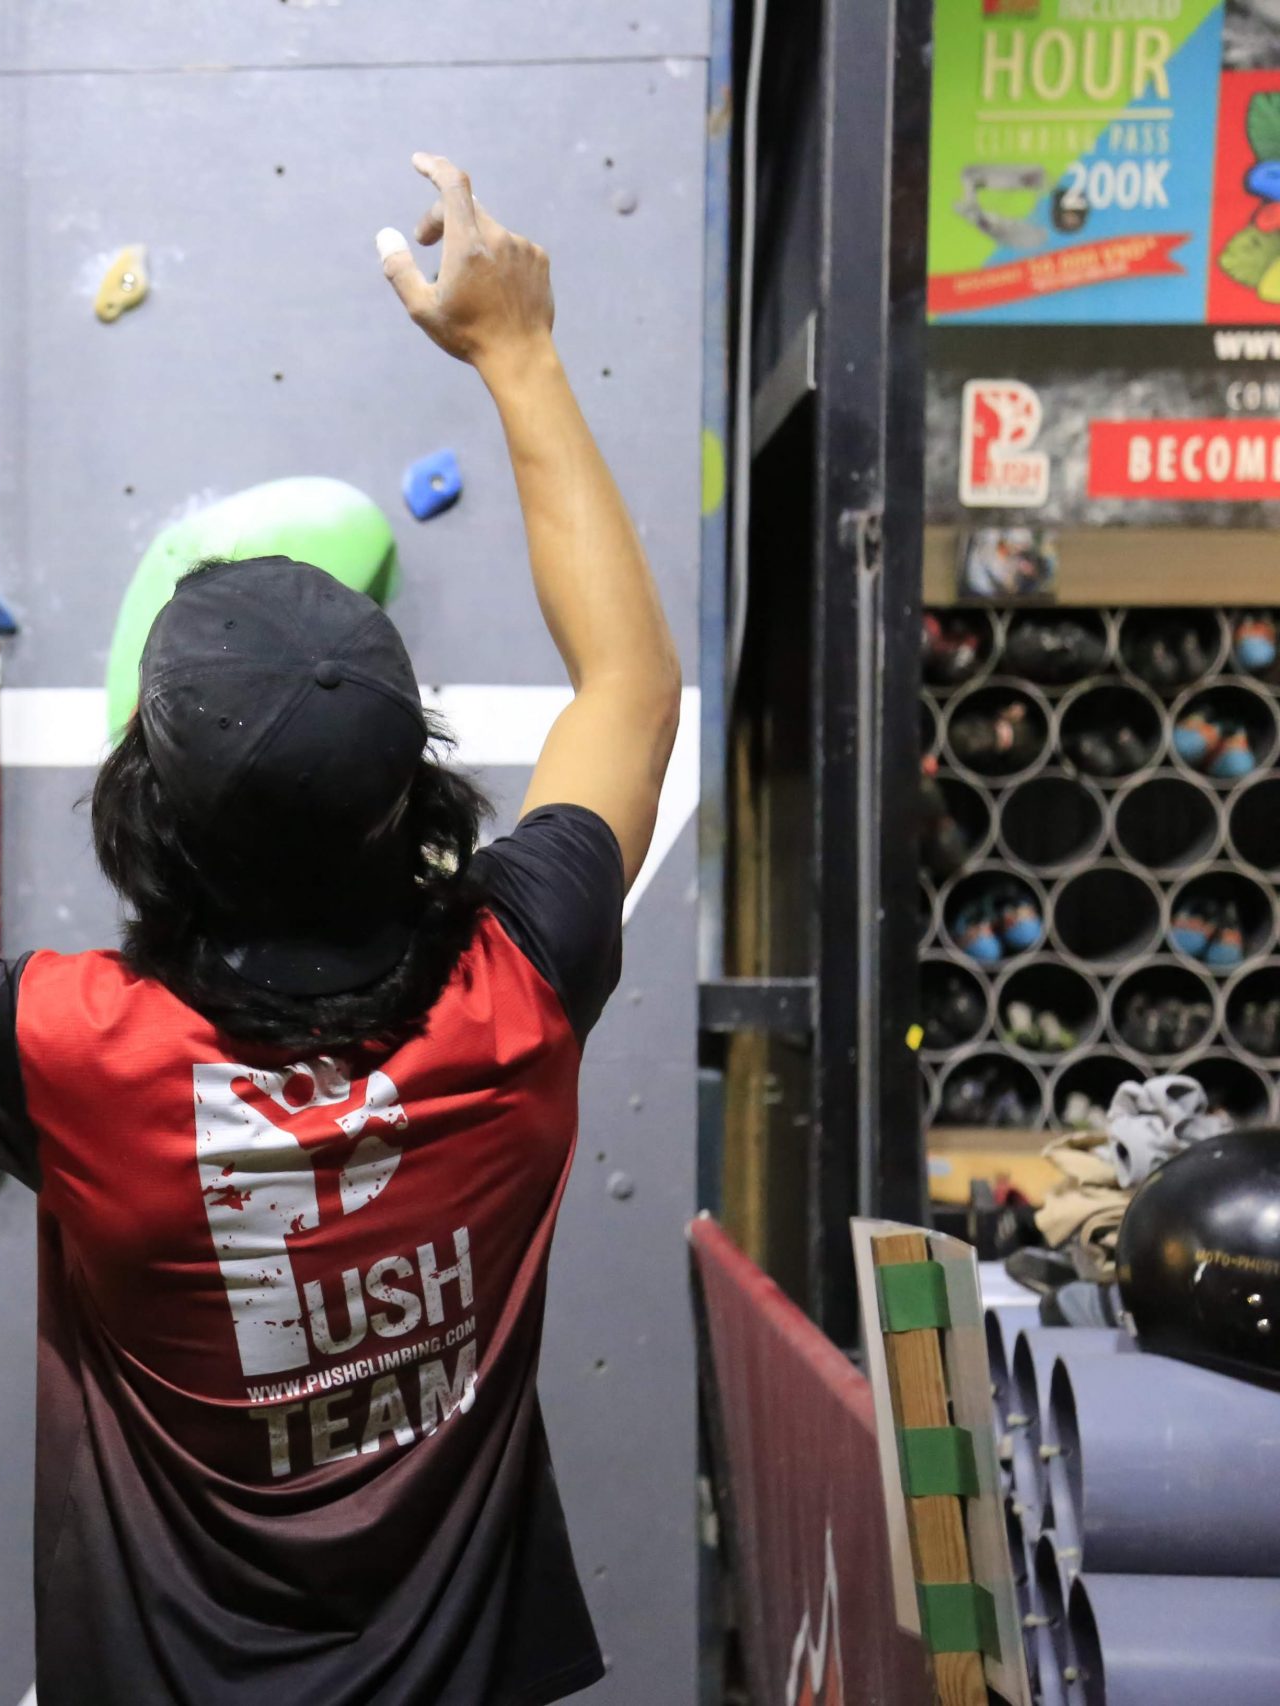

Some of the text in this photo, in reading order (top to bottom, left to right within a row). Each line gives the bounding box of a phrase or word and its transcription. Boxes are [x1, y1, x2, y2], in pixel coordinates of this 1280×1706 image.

[981, 27, 1172, 101] HOUR
[1109, 123, 1171, 155] PASS
[1061, 160, 1172, 210] 200K
[246, 1315, 477, 1403] WWW.PUSHCLIMBING.COM
[248, 1338, 479, 1478] TEAM
